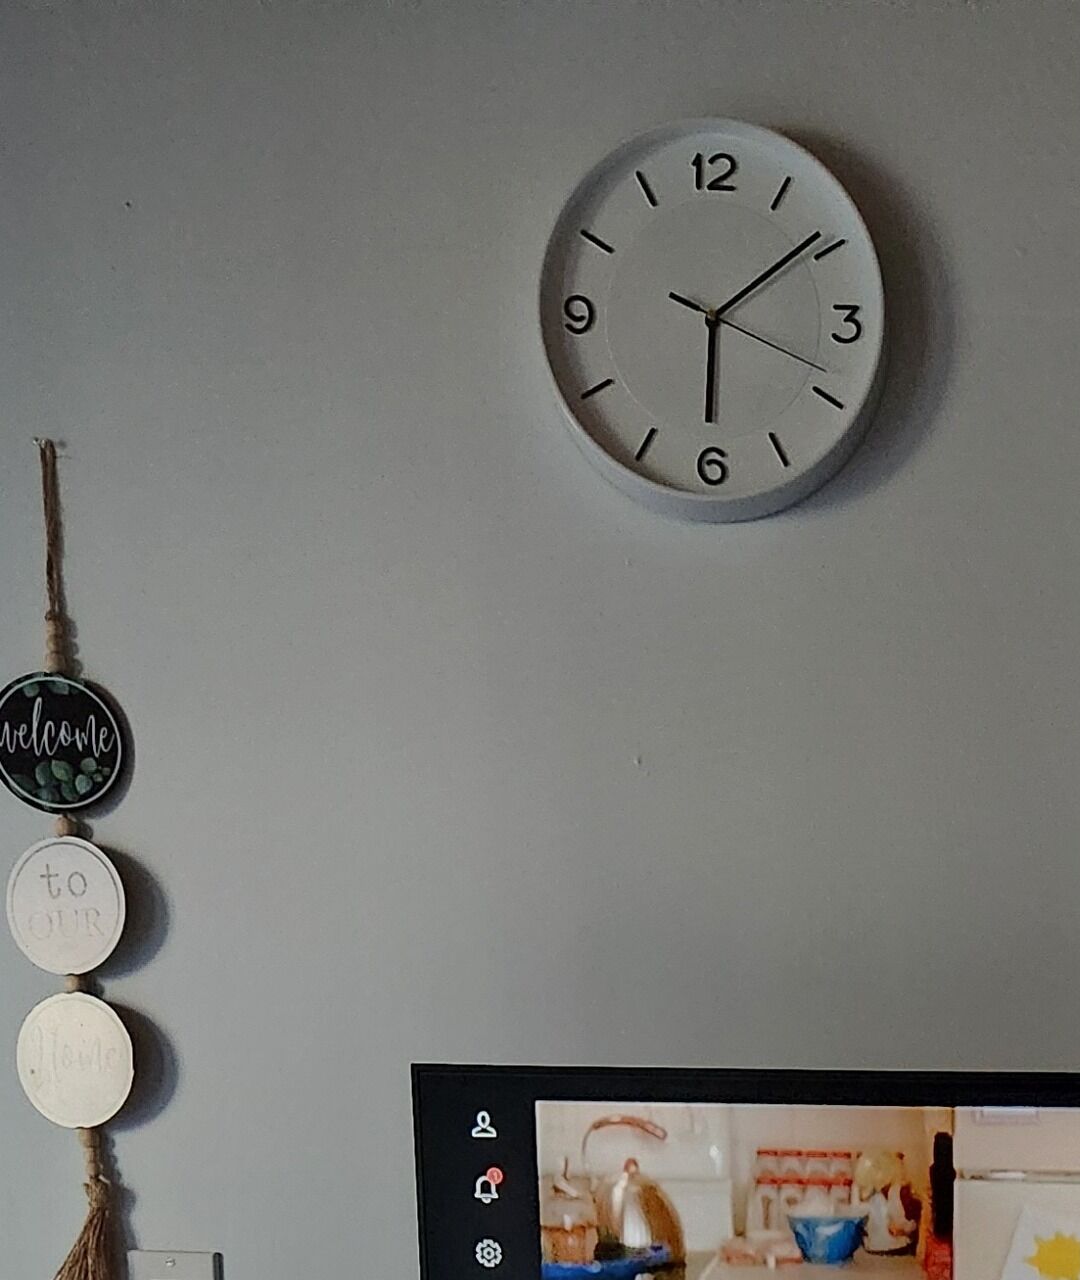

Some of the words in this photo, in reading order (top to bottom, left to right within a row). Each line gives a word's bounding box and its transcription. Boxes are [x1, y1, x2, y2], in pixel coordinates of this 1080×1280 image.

[692, 153, 737, 191] 12
[564, 295, 594, 334] 9
[832, 304, 862, 344] 3
[697, 446, 728, 485] 6
[0, 697, 115, 757] welcome
[40, 863, 88, 899] to
